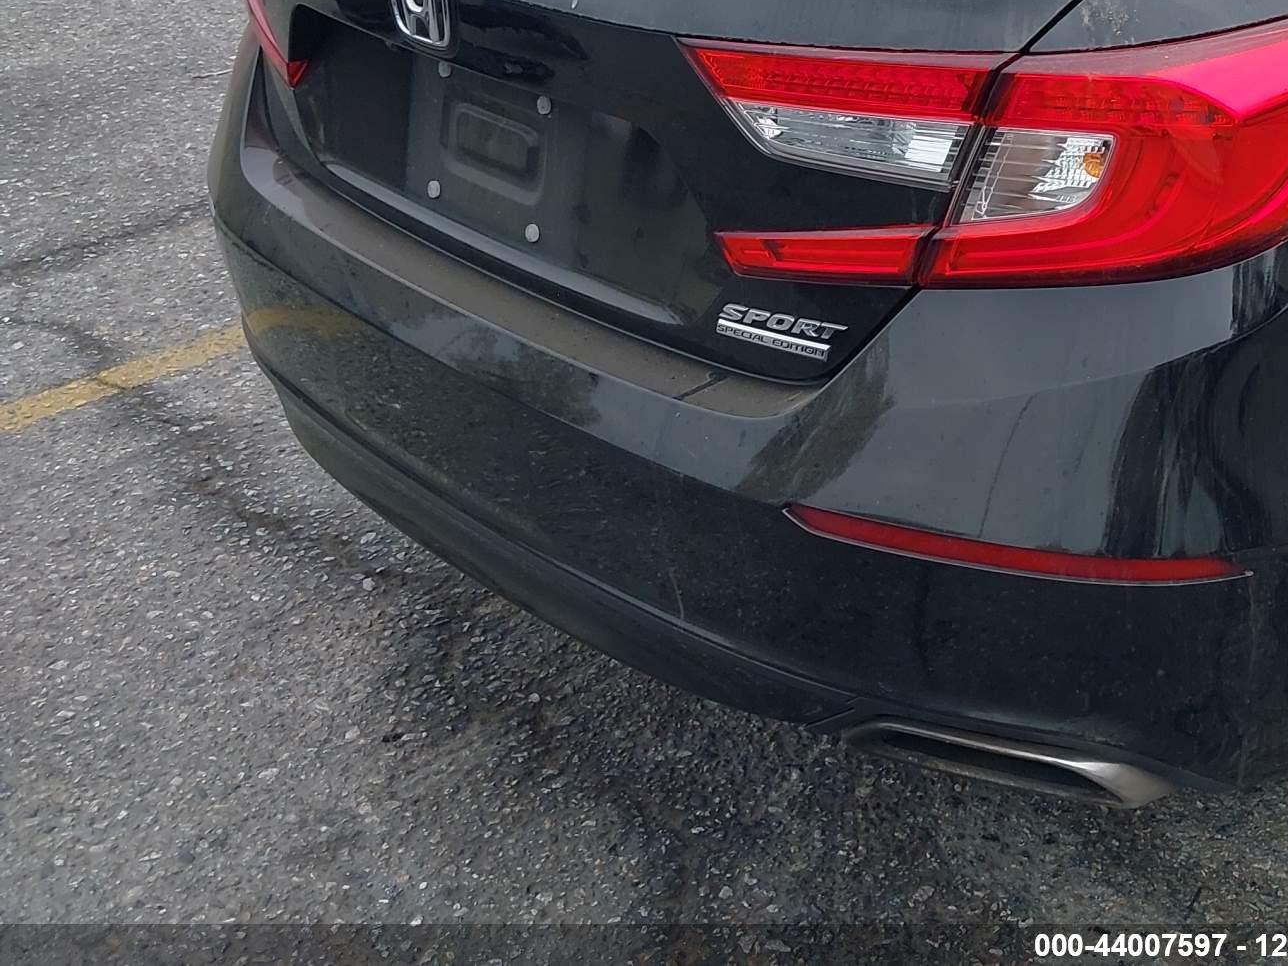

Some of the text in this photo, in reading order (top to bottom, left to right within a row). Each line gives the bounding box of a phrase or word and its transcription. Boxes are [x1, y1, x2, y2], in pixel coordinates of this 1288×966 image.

[718, 303, 848, 340] SPORT
[717, 324, 827, 359] SPECIAL EDITION
